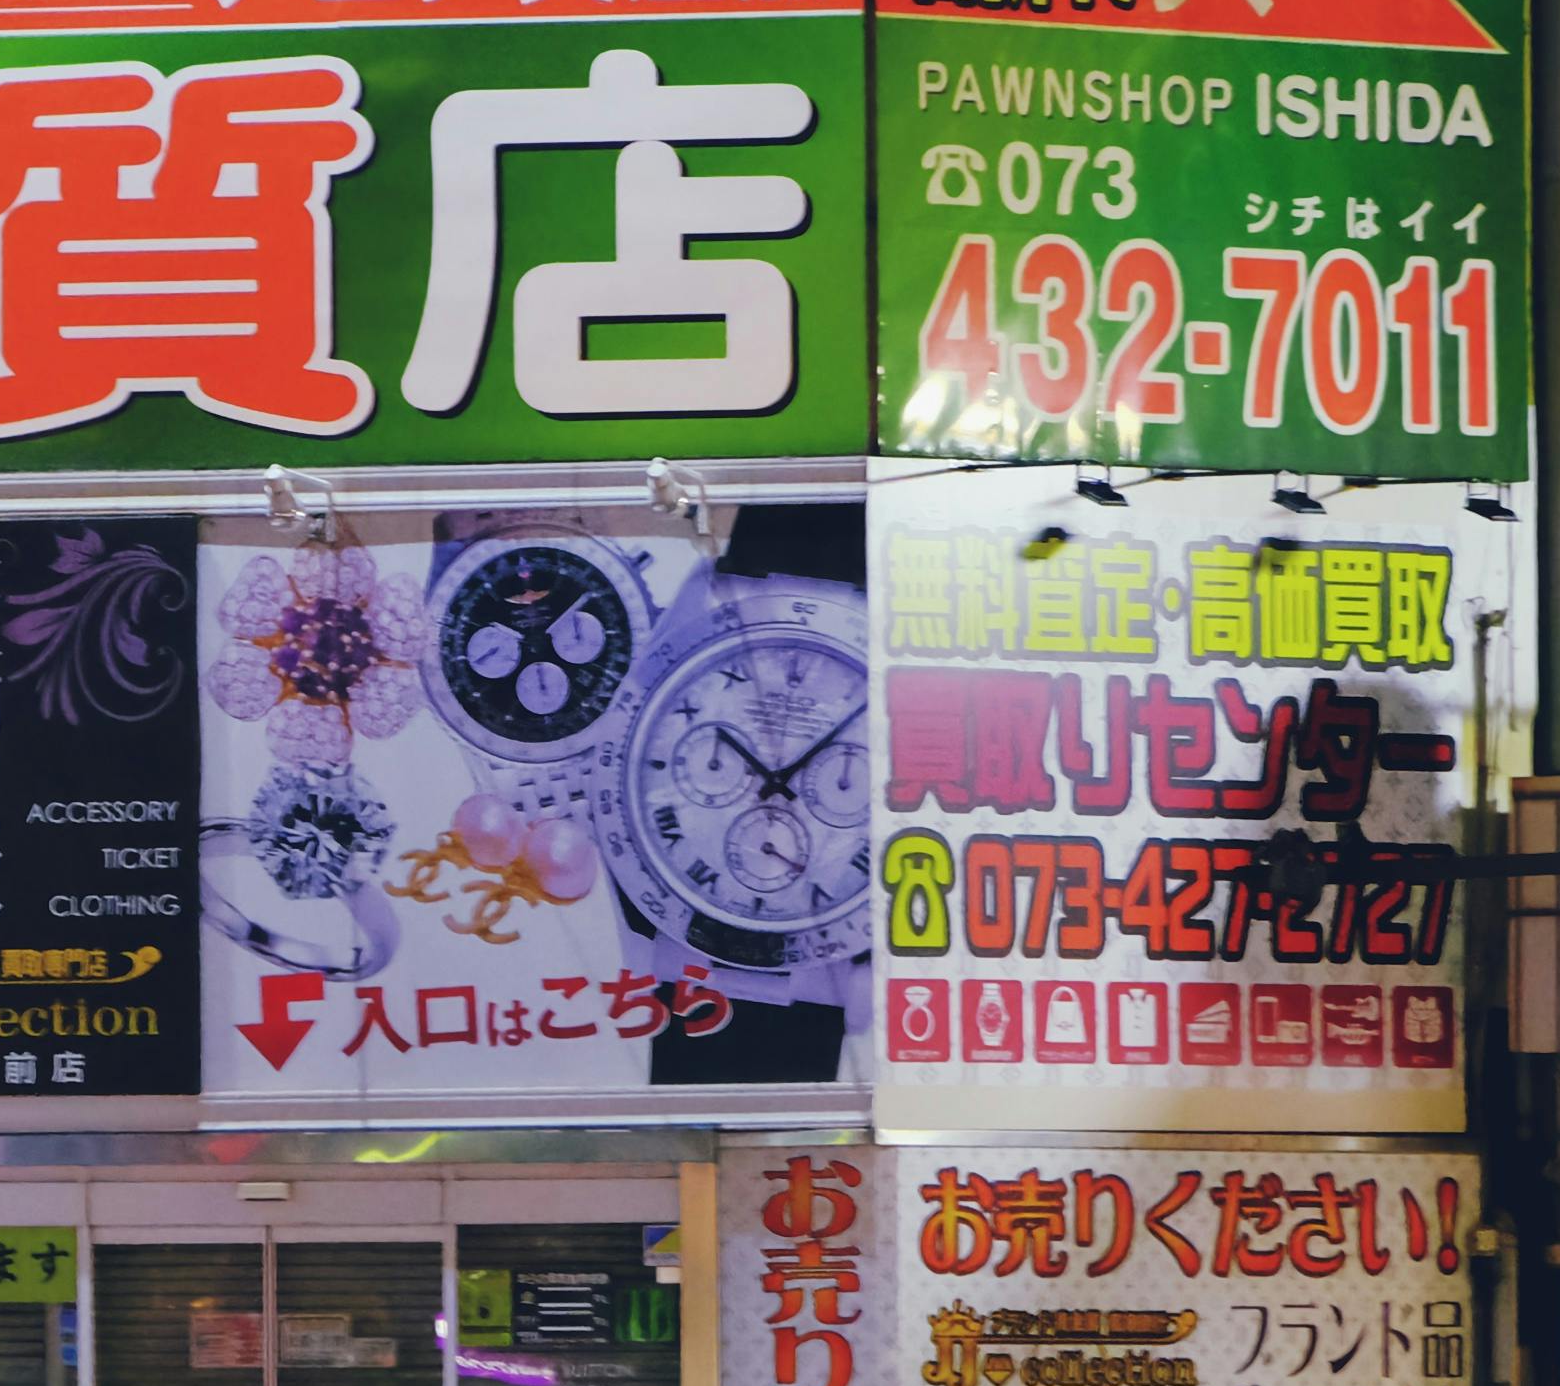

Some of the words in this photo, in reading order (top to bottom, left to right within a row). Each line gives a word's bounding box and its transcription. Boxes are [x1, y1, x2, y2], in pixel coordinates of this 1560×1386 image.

[917, 60, 1234, 128] PAWNSHOP
[1255, 72, 1494, 149] ISHIDA
[997, 140, 1138, 220] 073
[919, 233, 1498, 436] 432-7011
[884, 665, 1456, 823] 買取りセンター
[25, 800, 181, 825] ACCESSORY
[100, 846, 181, 871] TICKET
[48, 893, 182, 919] CLOTHING
[341, 965, 733, 1058] 入口はこちら
[918, 1166, 1462, 1279] お売りください!
[1230, 1300, 1465, 1380] ブランド品
